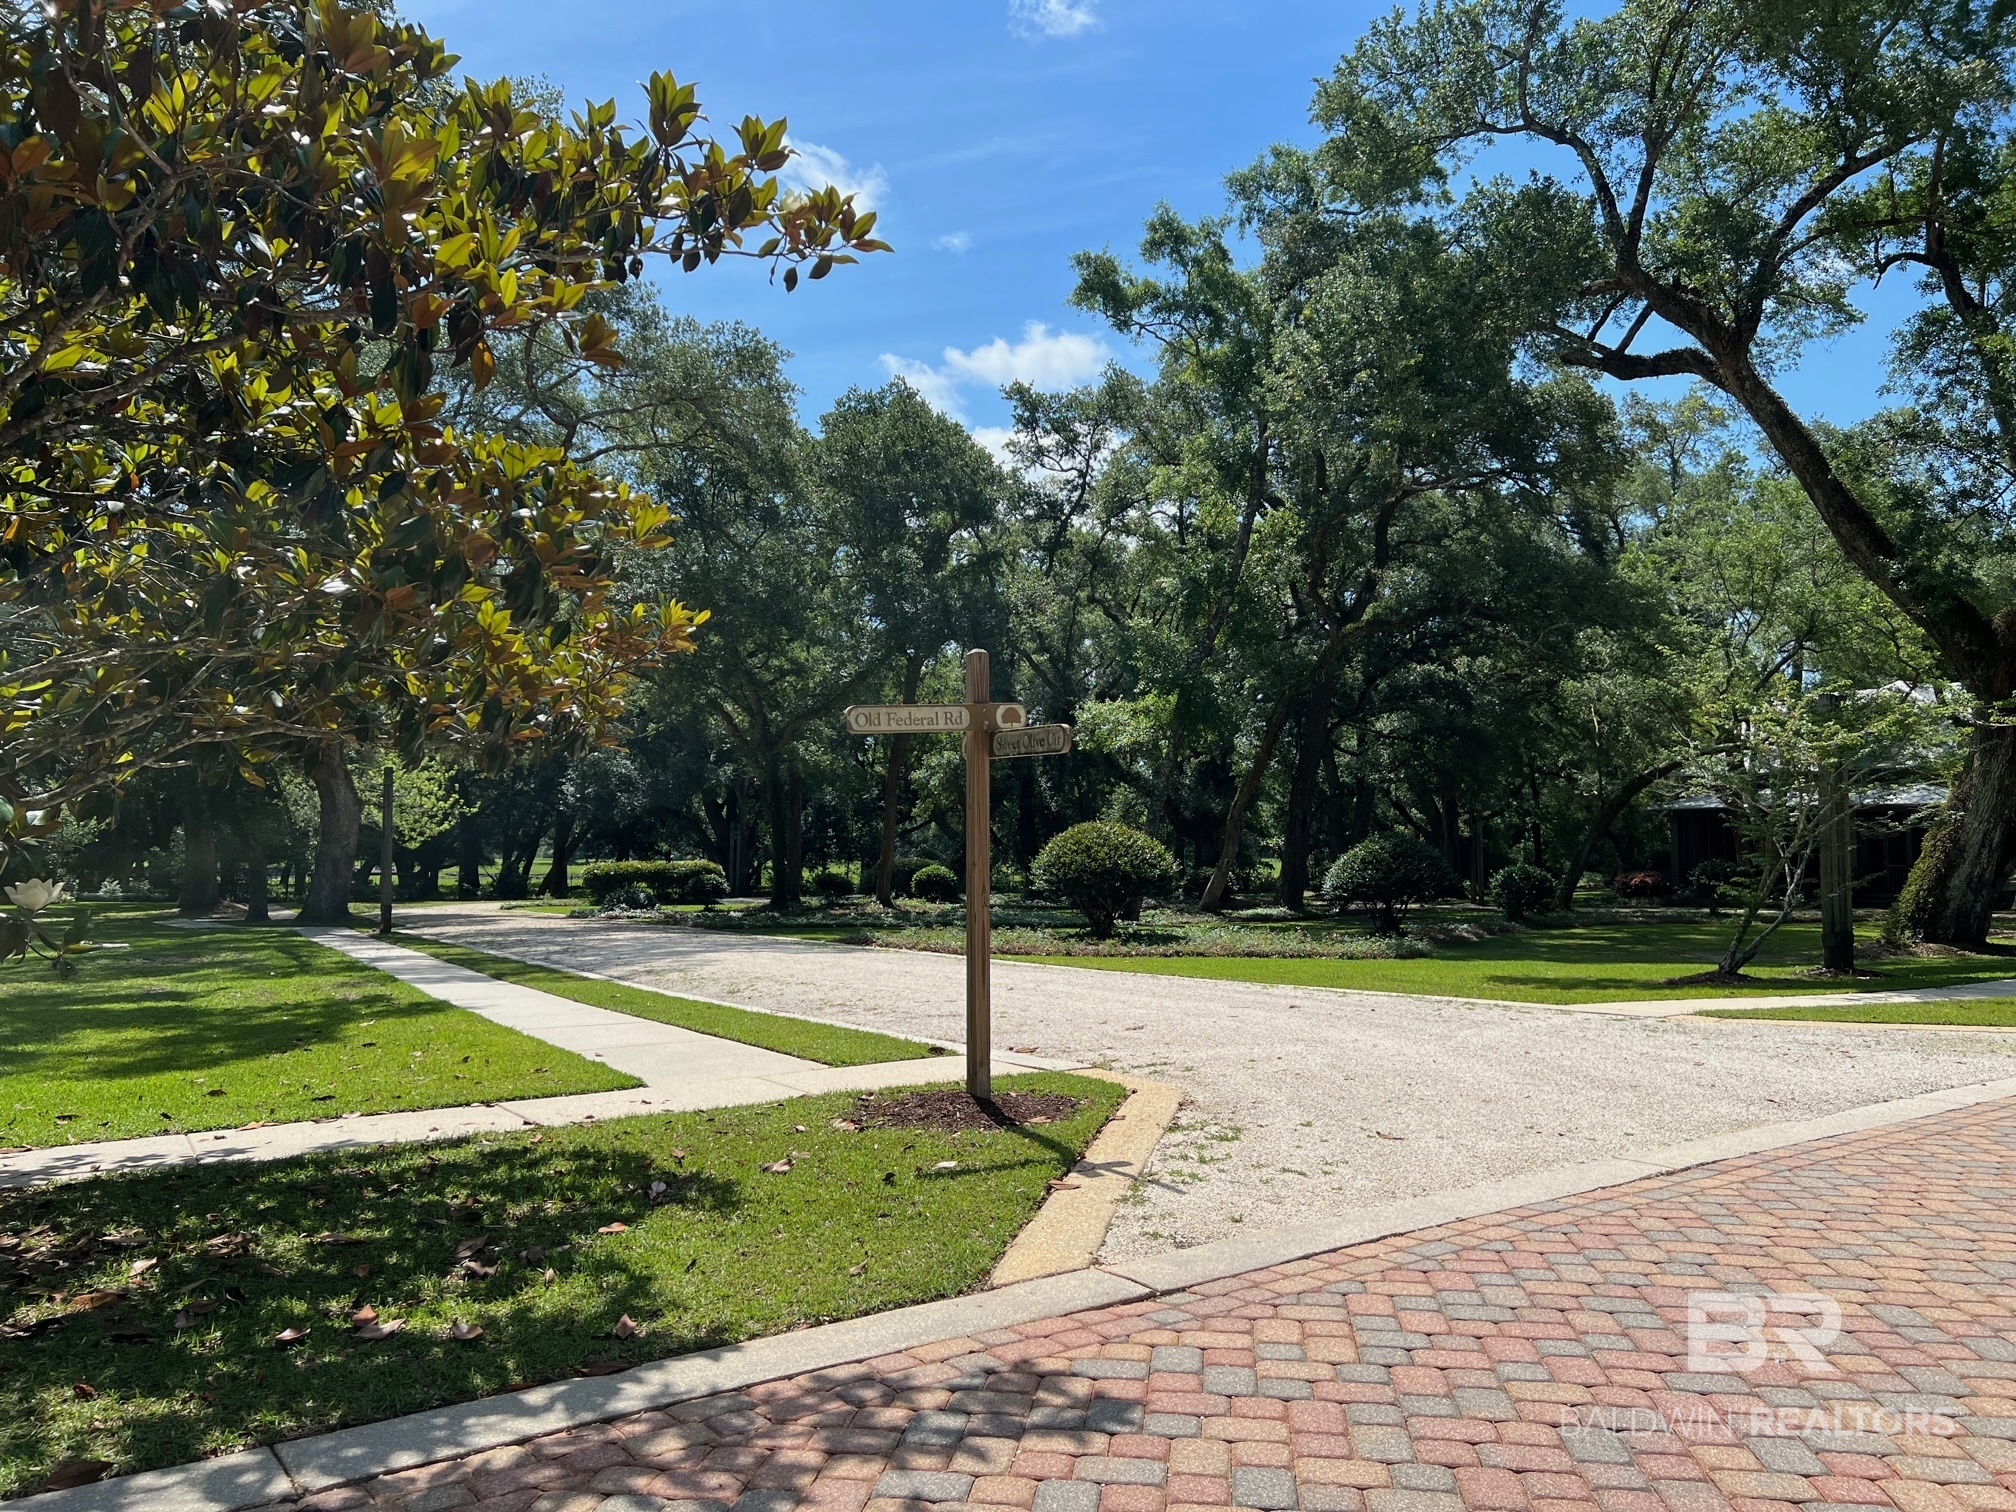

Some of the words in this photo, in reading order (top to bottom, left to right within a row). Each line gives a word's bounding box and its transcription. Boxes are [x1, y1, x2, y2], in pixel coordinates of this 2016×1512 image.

[855, 712, 882, 728] Old
[887, 711, 940, 727] Federal
[944, 711, 963, 726] Rd
[1022, 733, 1046, 749] Olive
[1048, 732, 1062, 747] Cir
